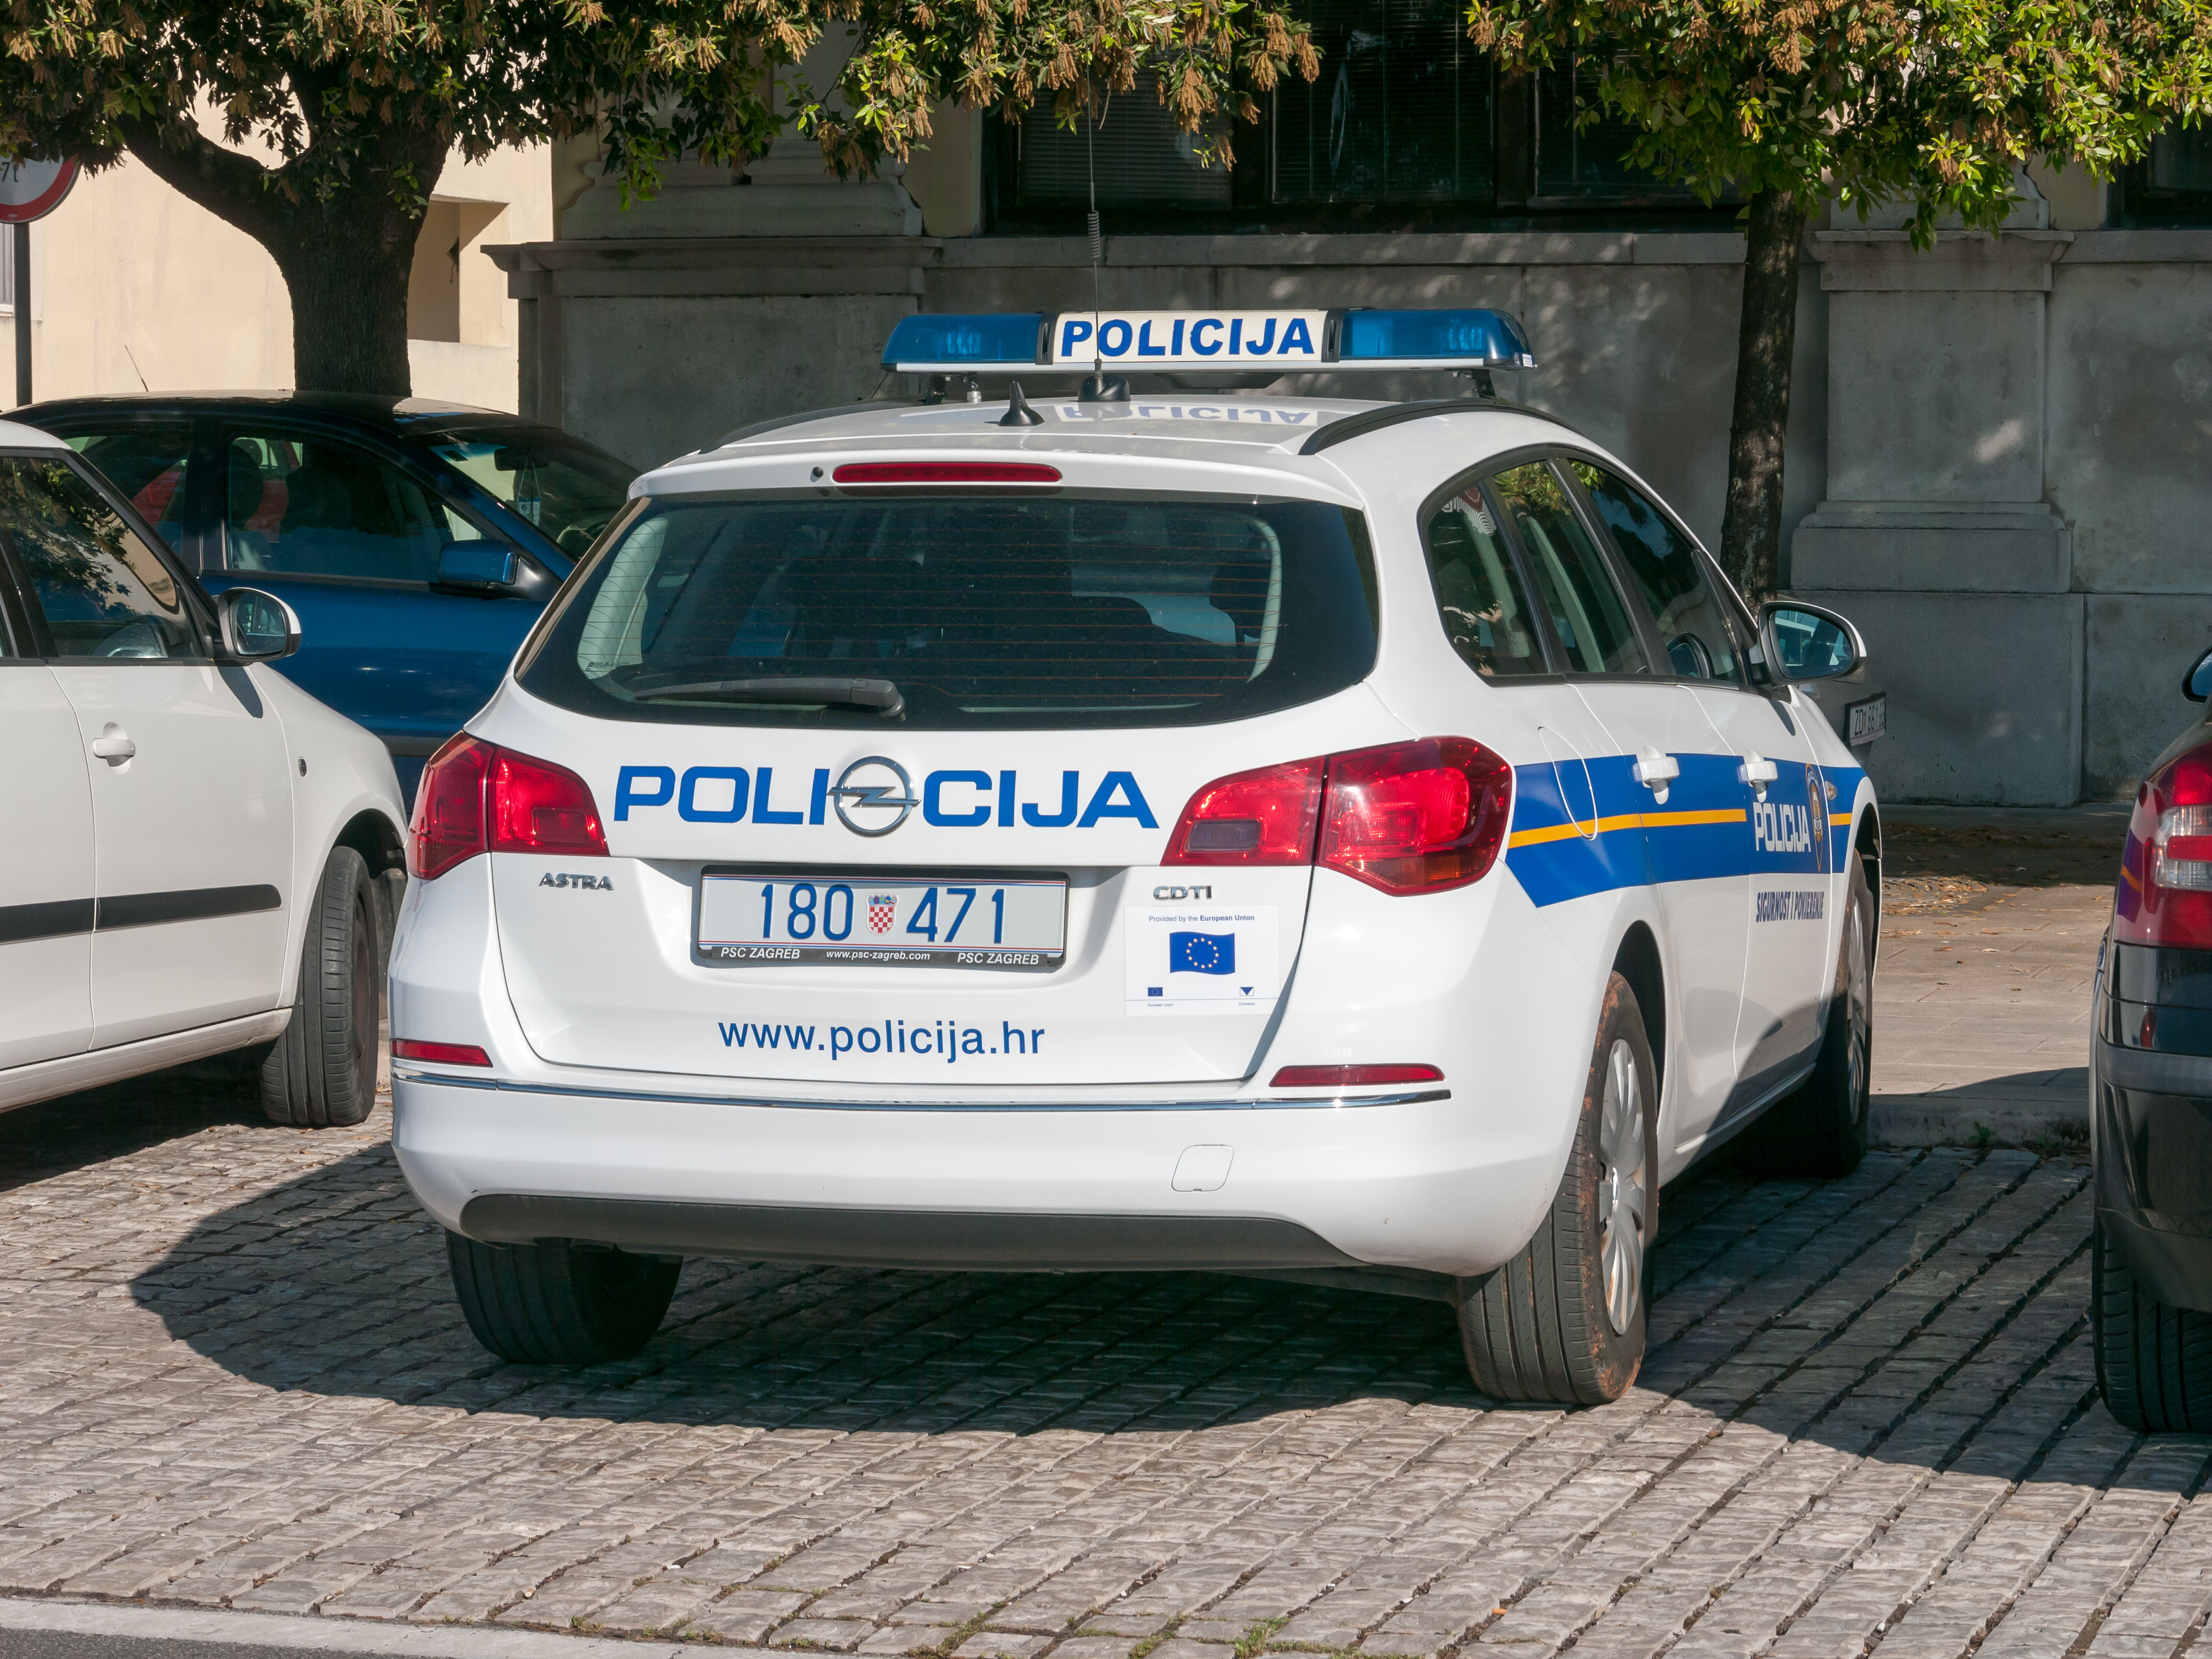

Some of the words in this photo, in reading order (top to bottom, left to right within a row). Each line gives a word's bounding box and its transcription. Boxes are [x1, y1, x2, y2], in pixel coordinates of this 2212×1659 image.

[1061, 318, 1315, 357] POLICIJA
[1854, 709, 1863, 735] ZD
[1753, 802, 1811, 852] POLICIJA
[538, 873, 614, 891] ASTRA
[1153, 885, 1212, 900] CDTI
[761, 883, 854, 941] 180
[906, 887, 1004, 944] 471
[1756, 891, 1791, 922] SIGURNOST
[1791, 891, 1794, 920] I
[721, 947, 746, 958] PSC
[749, 948, 800, 959] ZAGREB
[826, 951, 930, 962] www.psc-zagreb.com
[957, 952, 983, 963] PSC
[986, 953, 1039, 965] ZAGREB
[718, 1020, 1045, 1063] www.policija.hr
